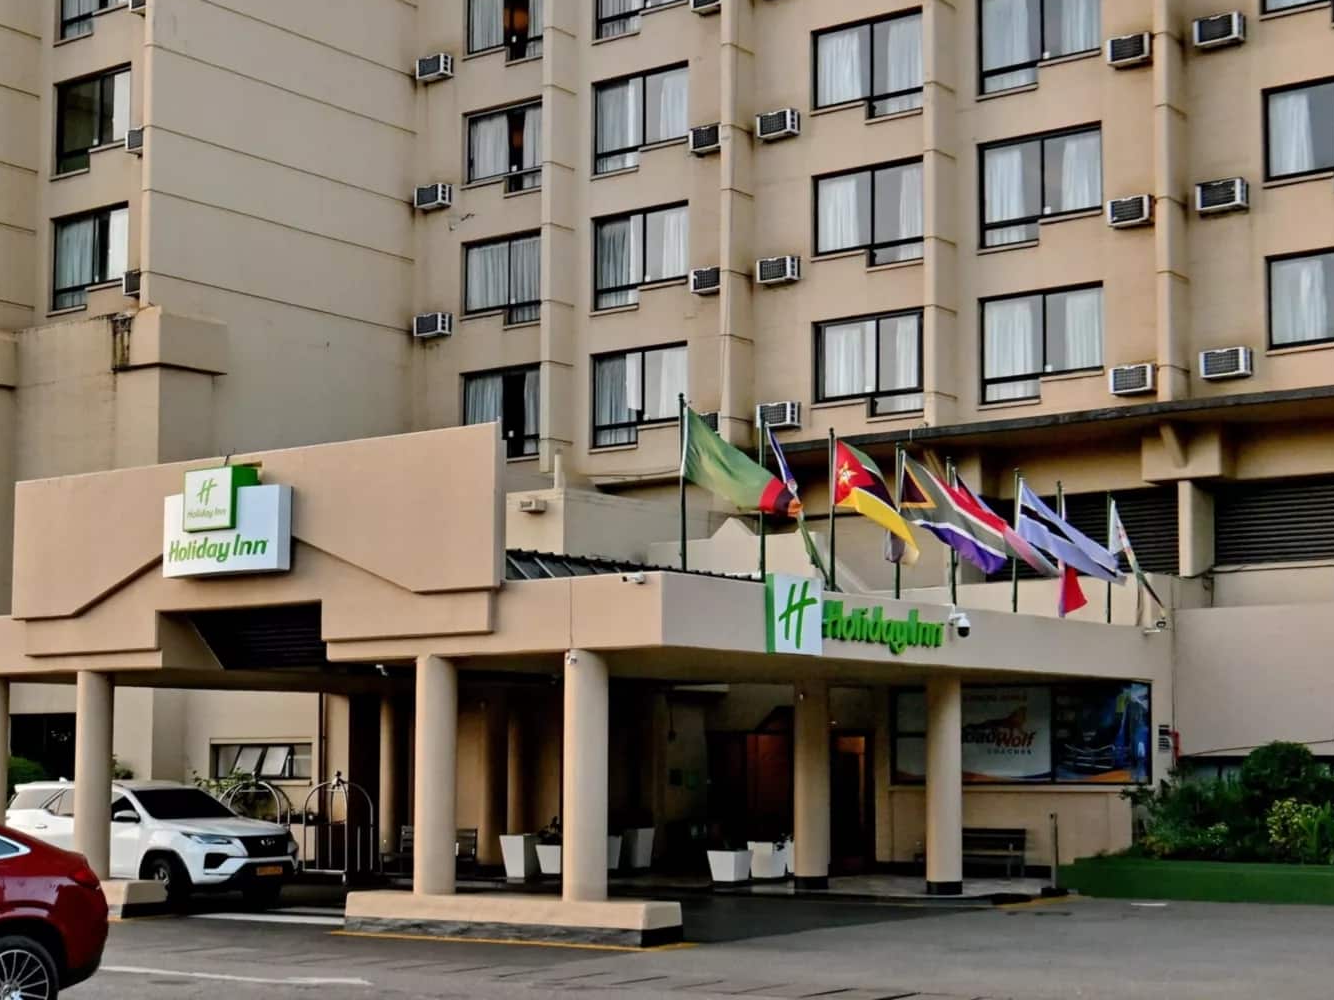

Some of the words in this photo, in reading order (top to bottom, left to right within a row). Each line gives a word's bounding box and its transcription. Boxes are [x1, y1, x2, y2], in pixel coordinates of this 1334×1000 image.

[186, 508, 214, 518] Holiday
[168, 536, 231, 563] Holiday
[232, 533, 269, 556] Inn
[778, 580, 818, 649] H
[821, 600, 908, 656] Holiday
[906, 609, 945, 648] Inn
